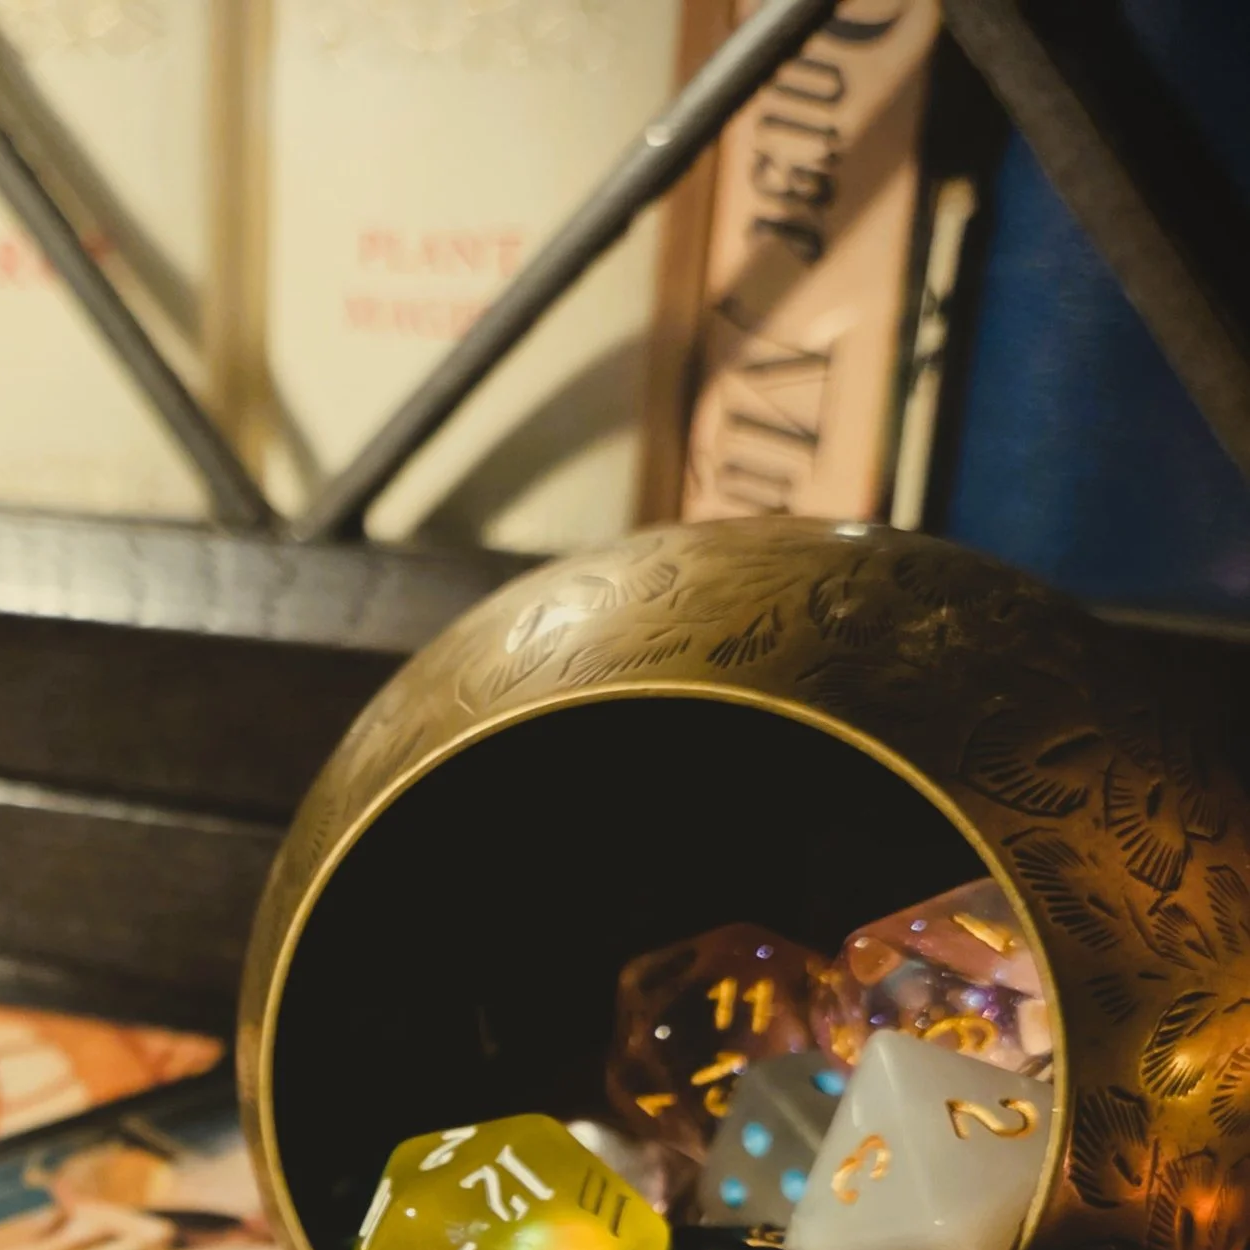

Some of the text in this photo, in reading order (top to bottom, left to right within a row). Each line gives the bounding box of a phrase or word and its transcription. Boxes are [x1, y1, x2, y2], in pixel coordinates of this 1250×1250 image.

[946, 1097, 1039, 1140] 2
[460, 1145, 555, 1222] 12
[831, 1134, 891, 1205] 3
